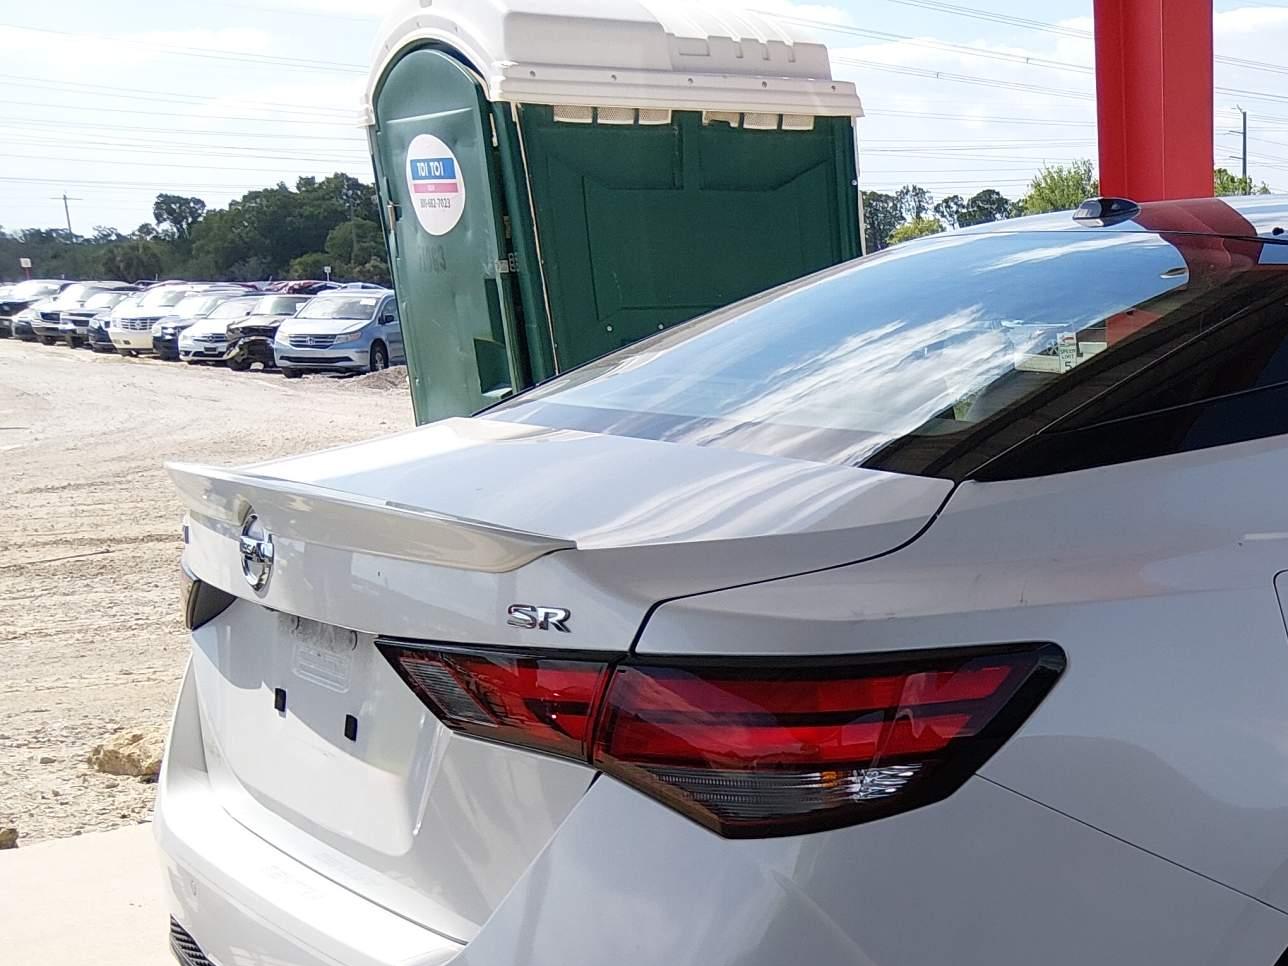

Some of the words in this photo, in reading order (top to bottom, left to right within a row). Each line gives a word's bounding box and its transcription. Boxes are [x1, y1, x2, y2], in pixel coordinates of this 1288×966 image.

[416, 161, 428, 177] TOI
[429, 161, 444, 177] TOI
[507, 604, 572, 633] SR
